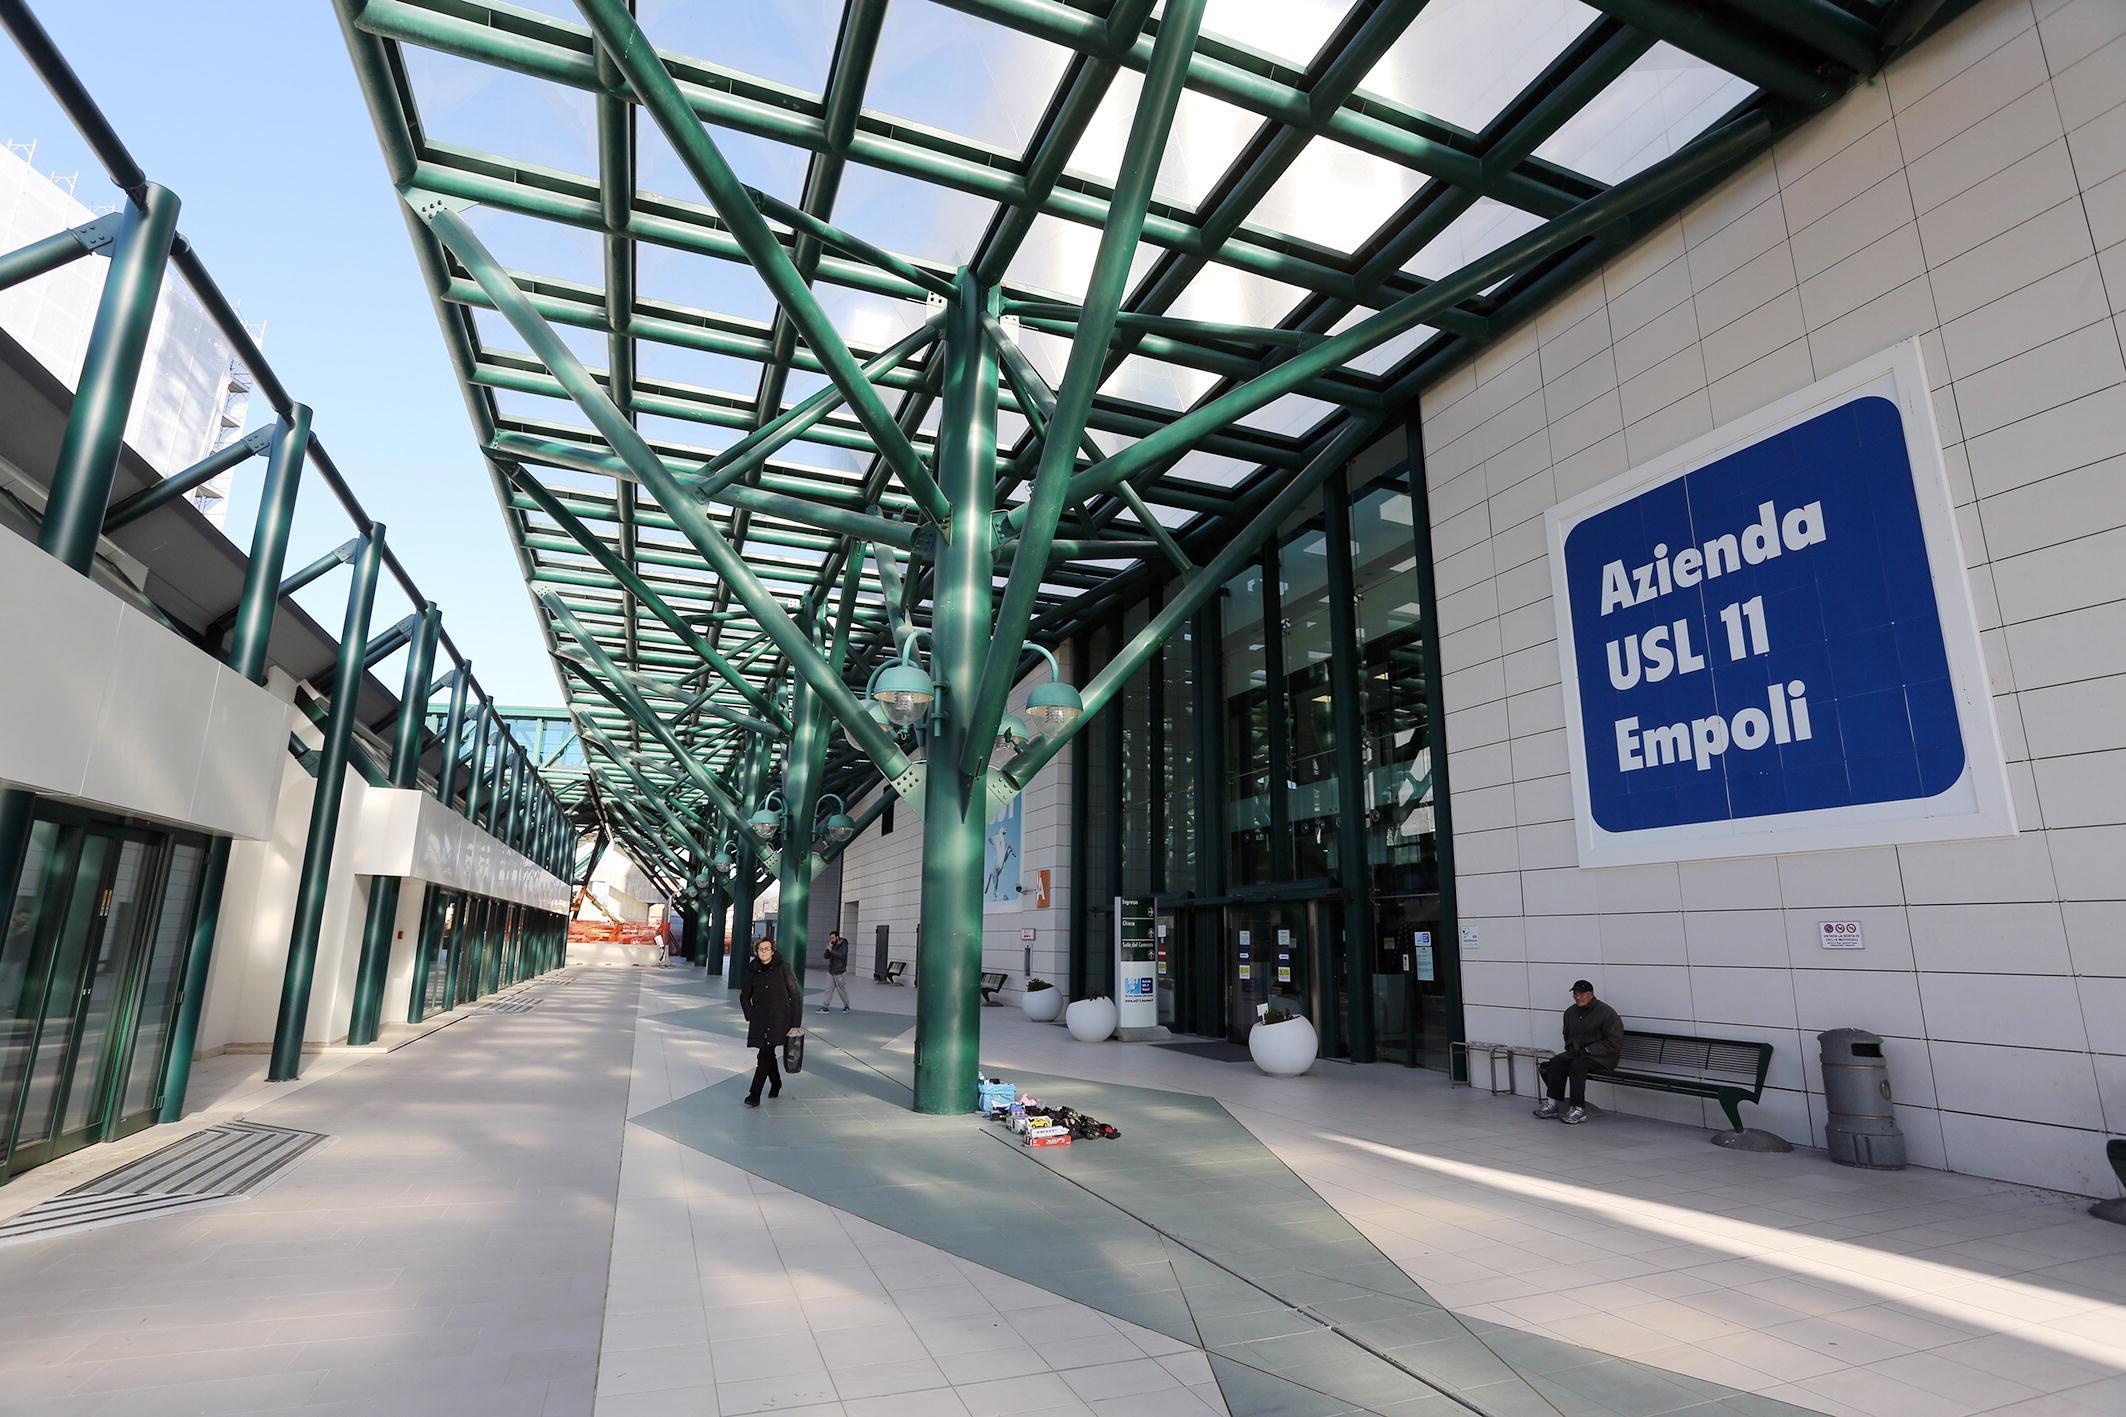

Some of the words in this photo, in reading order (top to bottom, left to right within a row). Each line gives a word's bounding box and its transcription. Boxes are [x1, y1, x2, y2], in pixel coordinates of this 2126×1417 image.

[1600, 500, 1827, 617] Azienda
[1605, 618, 1705, 691] USL
[1720, 595, 1770, 661] 11
[1614, 679, 1812, 773] Empoli
